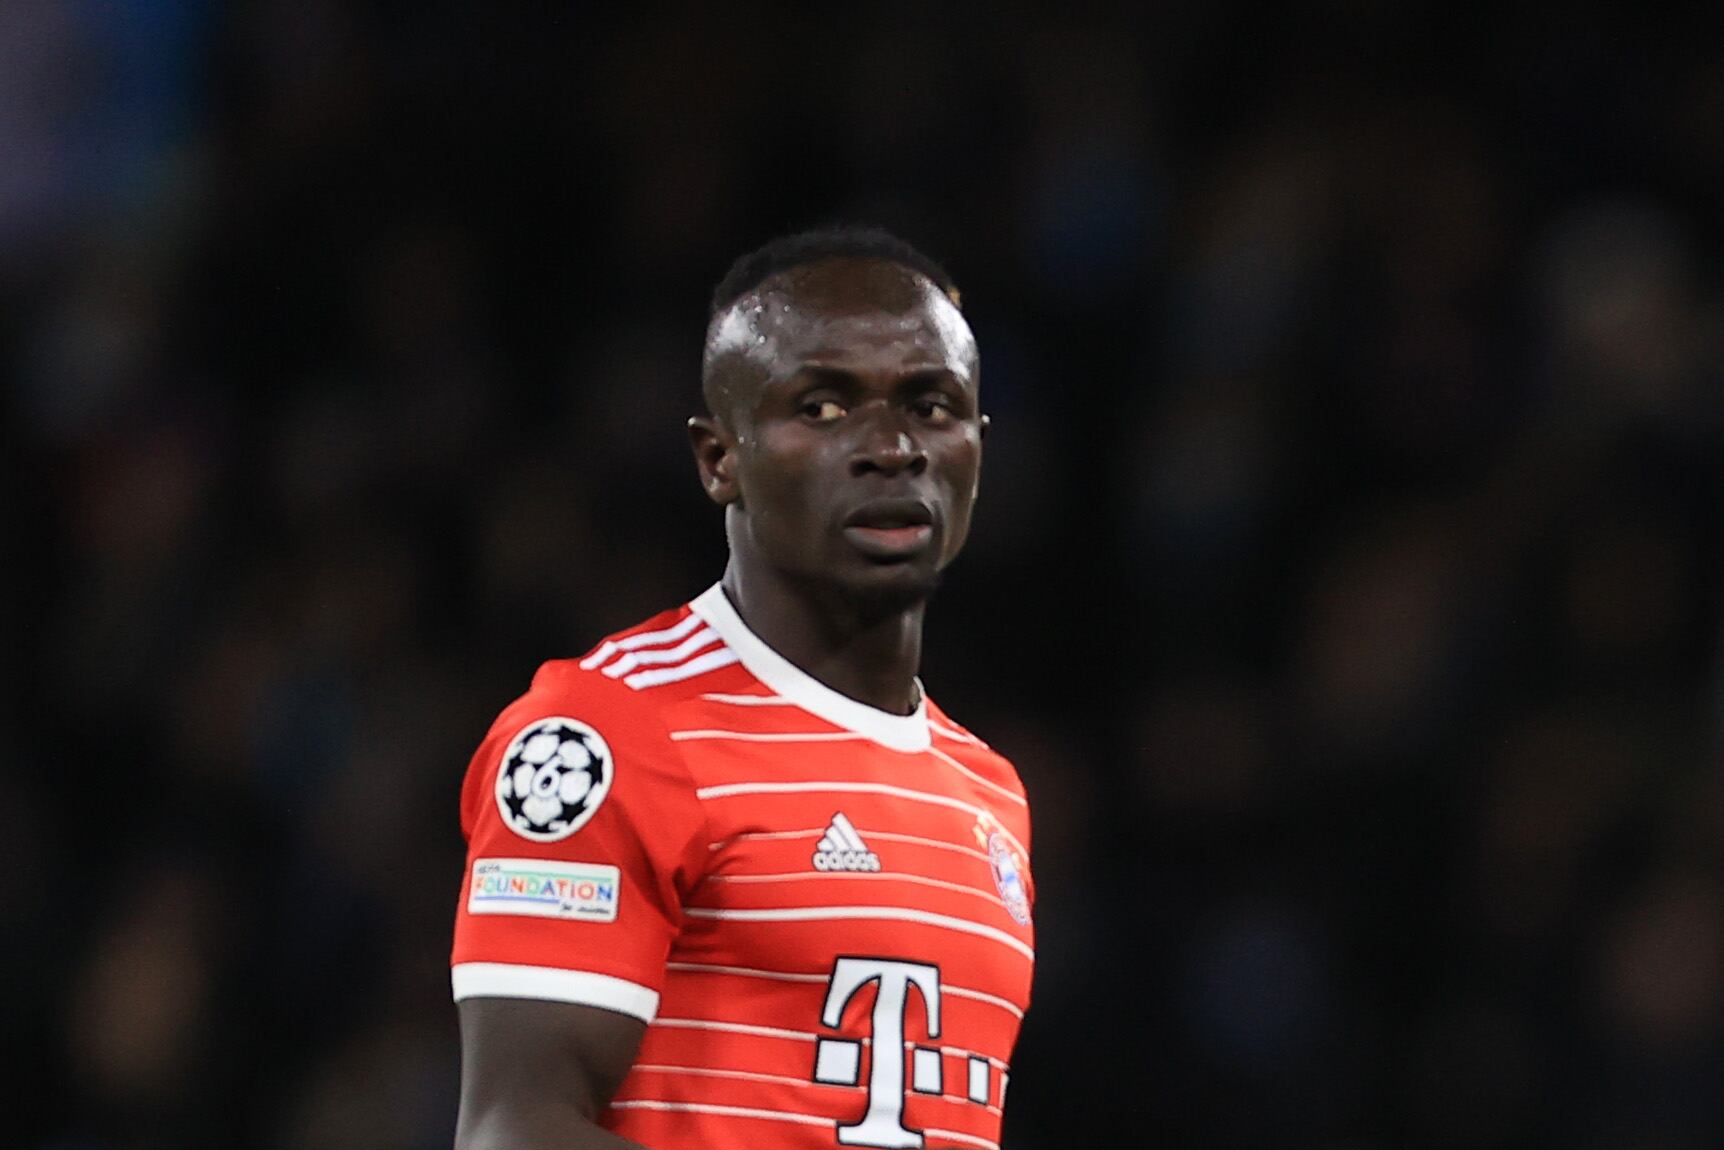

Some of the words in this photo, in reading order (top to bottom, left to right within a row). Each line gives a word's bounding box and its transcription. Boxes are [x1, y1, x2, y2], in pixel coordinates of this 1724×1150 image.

[812, 851, 881, 872] adidas
[475, 875, 613, 902] FOUNDATION
[820, 956, 941, 1149] T
